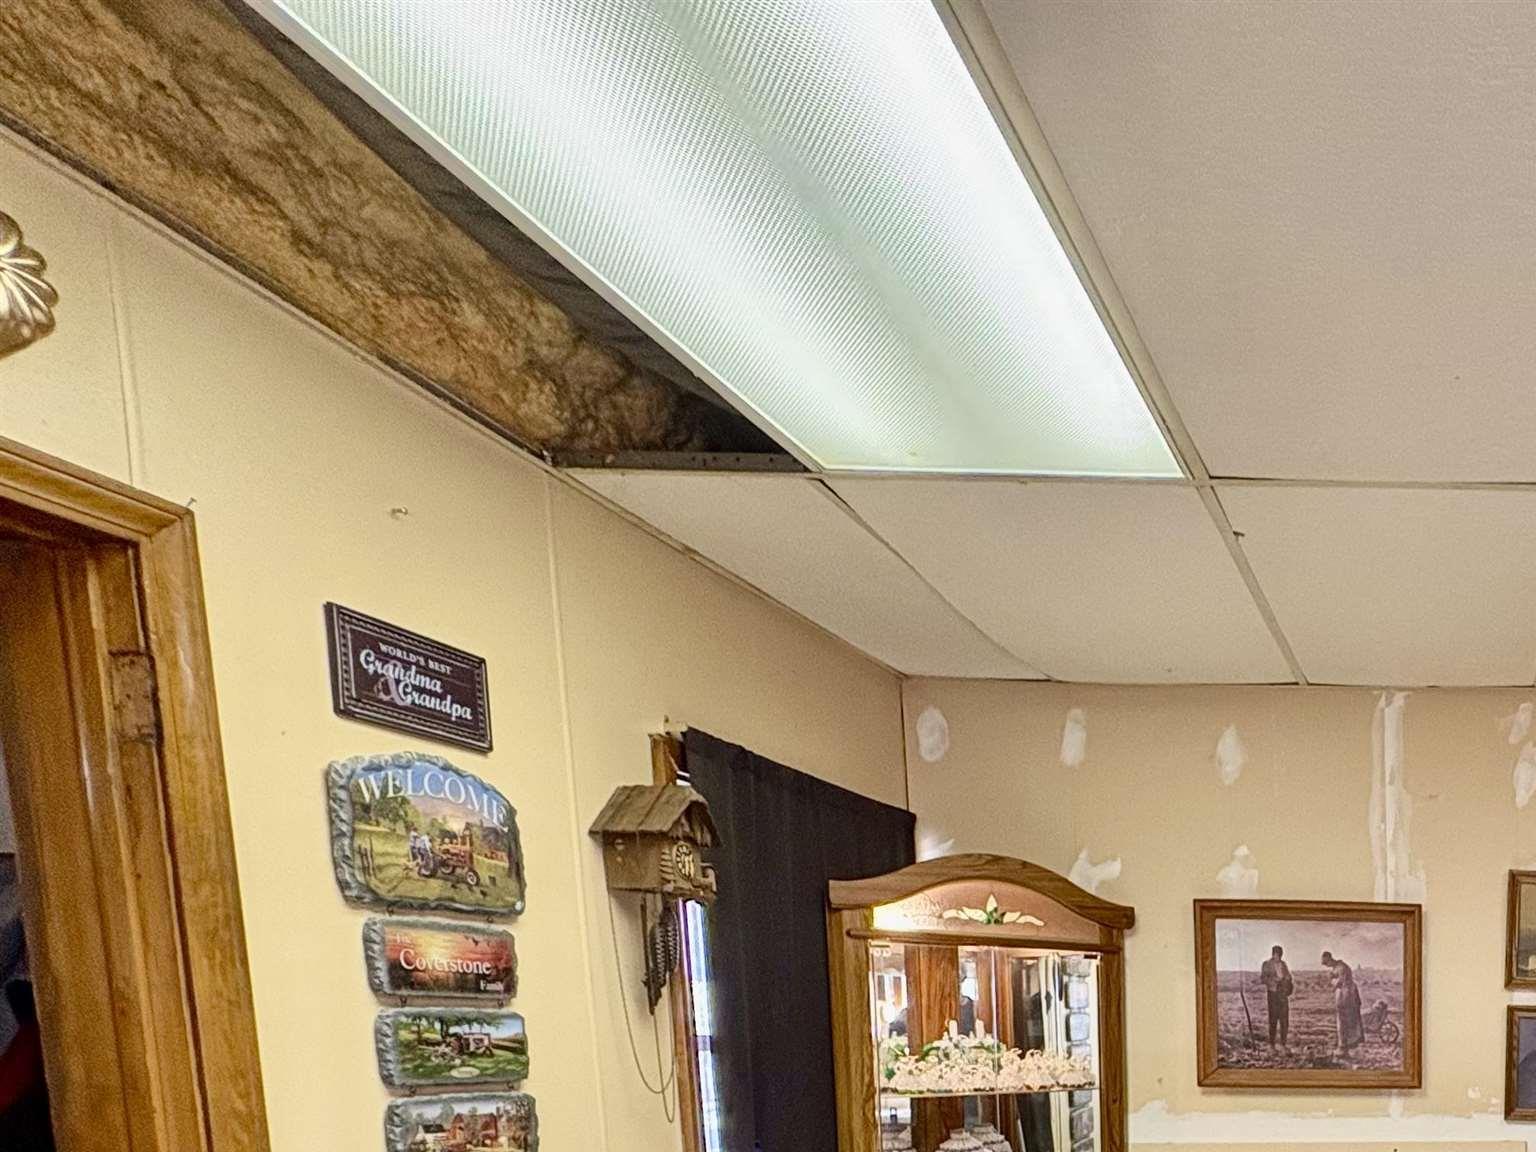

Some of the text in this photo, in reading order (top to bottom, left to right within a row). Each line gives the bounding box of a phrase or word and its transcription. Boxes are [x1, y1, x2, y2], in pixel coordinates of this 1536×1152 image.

[359, 648, 443, 693] Grandma
[378, 642, 453, 675] WORLD'S BEST
[398, 681, 474, 722] Grandpa
[357, 767, 510, 833] WELCOME
[399, 947, 493, 975] Coverstone
